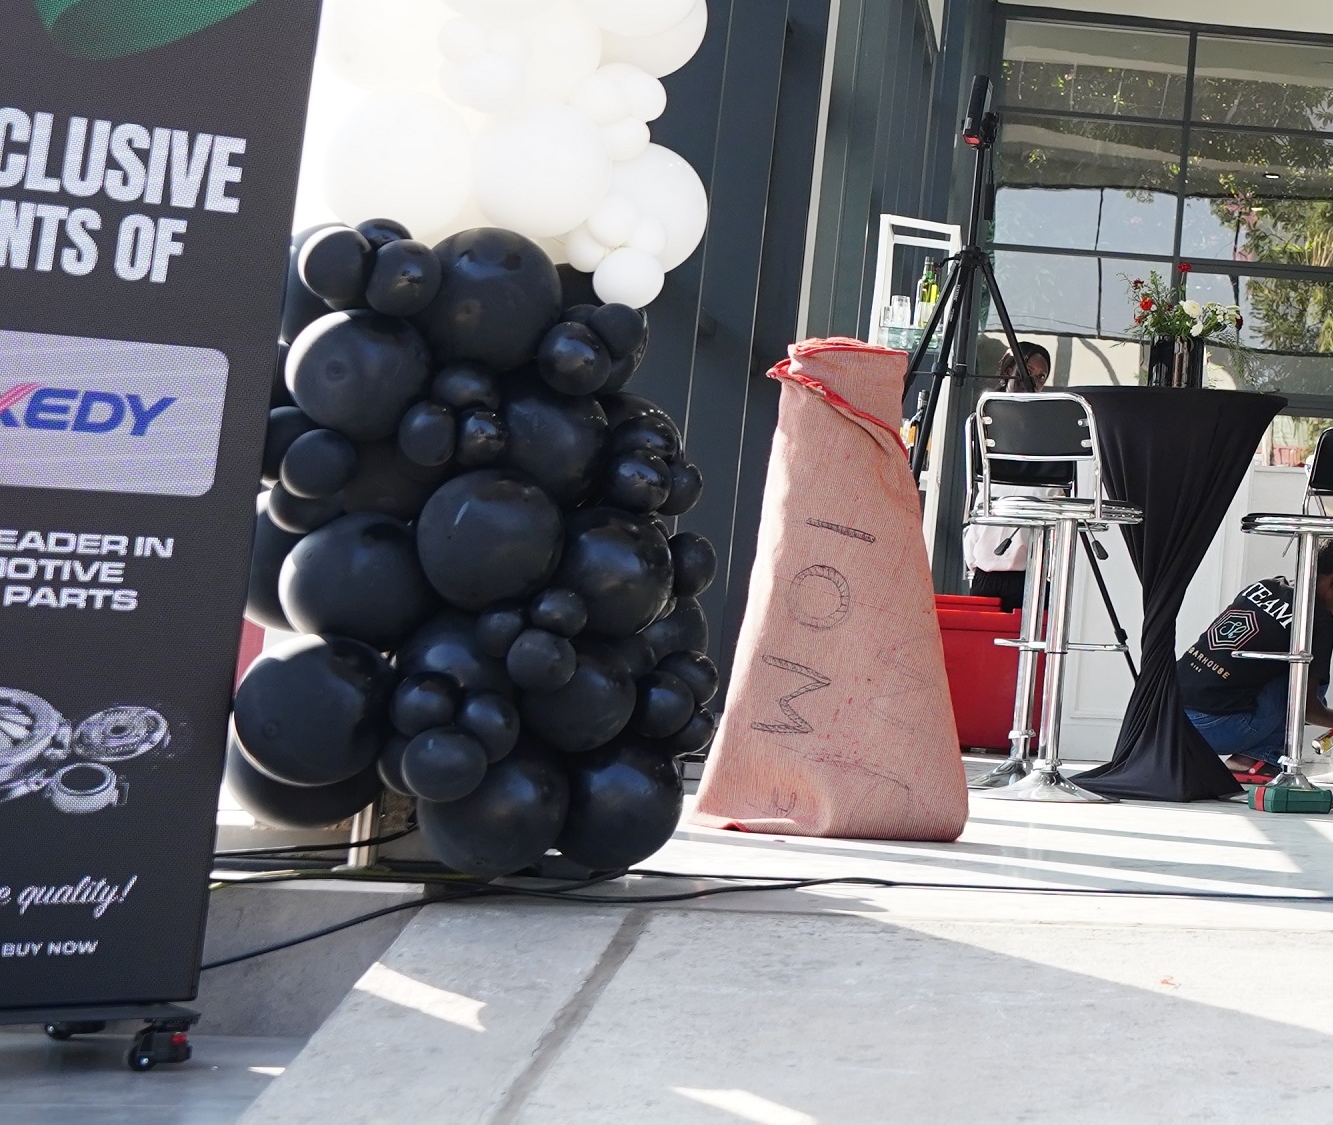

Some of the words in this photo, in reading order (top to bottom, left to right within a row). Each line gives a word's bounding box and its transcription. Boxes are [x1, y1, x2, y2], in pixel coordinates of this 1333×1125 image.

[0, 107, 247, 213] CLUSIVE
[0, 199, 102, 276] NTS
[114, 213, 188, 284] OF
[133, 536, 175, 558] IN
[3, 585, 139, 611] PARTS
[1241, 582, 1294, 630] TEAM
[17, 875, 138, 919] quality!
[2, 942, 43, 957] BUY
[47, 940, 99, 956] NOW
